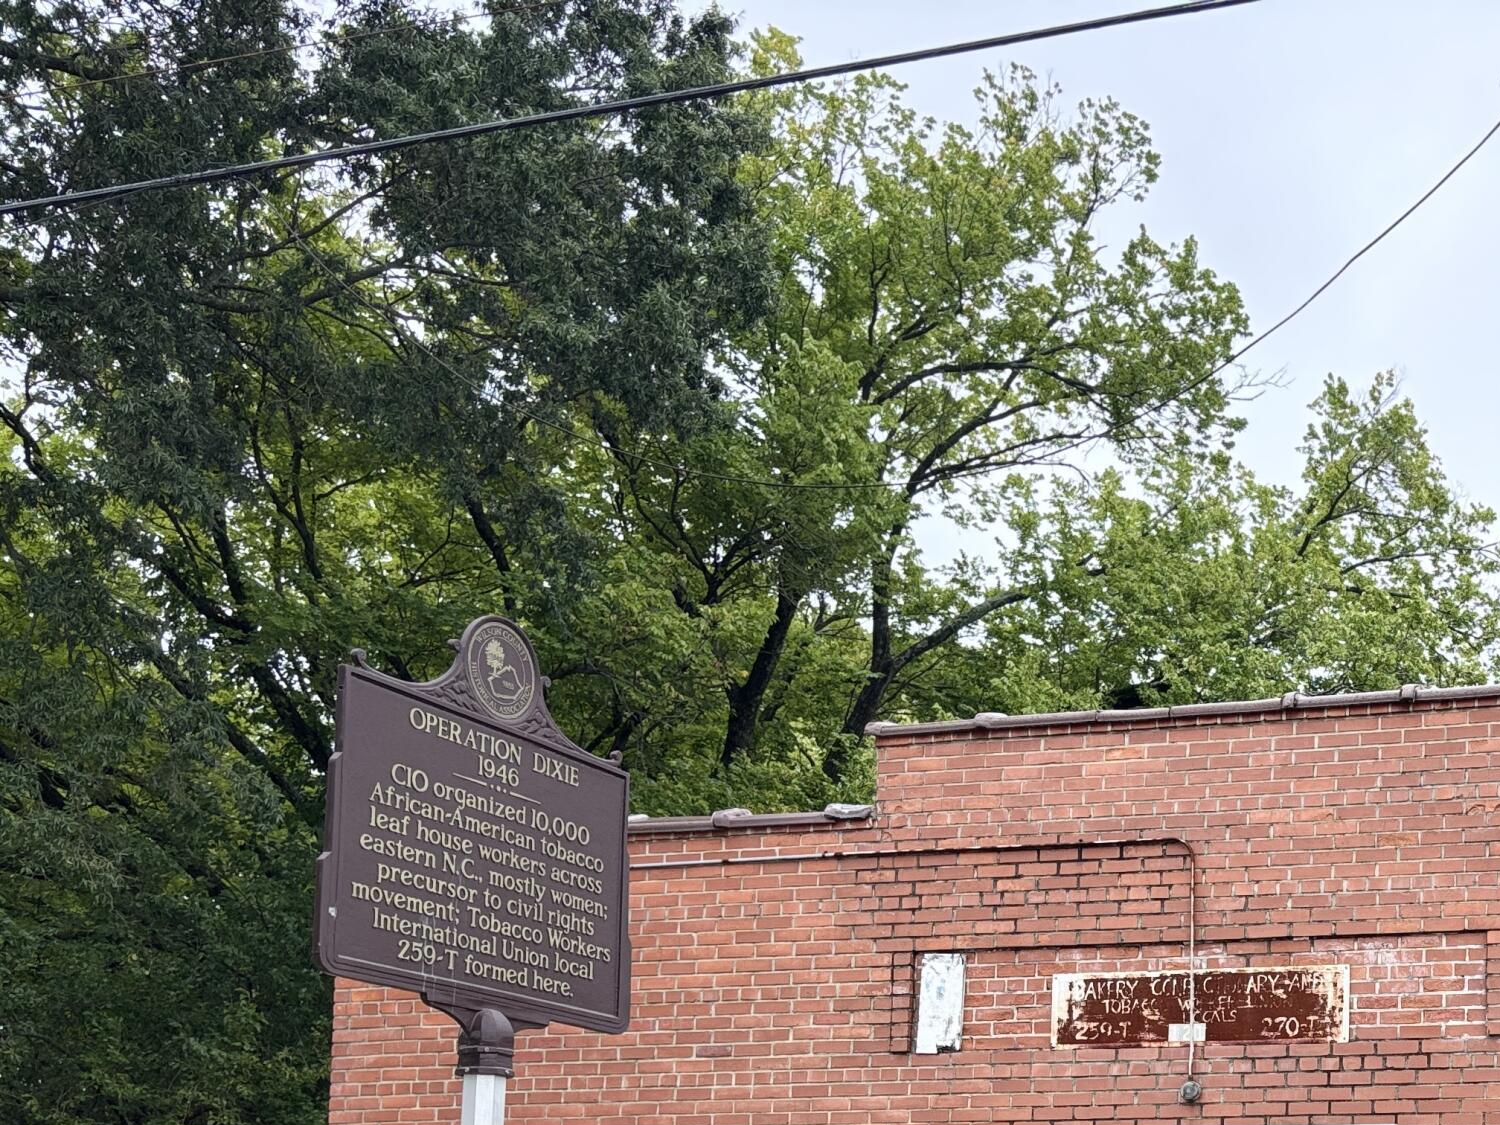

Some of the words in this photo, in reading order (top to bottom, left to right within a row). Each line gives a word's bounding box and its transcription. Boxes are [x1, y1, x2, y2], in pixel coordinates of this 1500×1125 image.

[475, 627, 502, 642] WILSON
[502, 631, 529, 662] COUNTY
[409, 707, 522, 766] OPERATION
[532, 752, 580, 787] DIXIE
[478, 755, 520, 787] 1946
[369, 782, 536, 851] African-American
[540, 836, 605, 873] tobacco
[391, 763, 429, 793] CIO
[433, 782, 526, 825] organized
[531, 808, 590, 846] 10,000
[360, 833, 436, 869] eastern
[443, 851, 483, 883] N.C.,
[489, 870, 547, 902] mostly
[550, 889, 608, 920] women;
[369, 805, 411, 836] leaf
[416, 819, 473, 854] house
[478, 844, 546, 877] workers
[551, 867, 603, 894] across
[351, 881, 460, 925] movement;
[467, 906, 543, 944] Tobacco
[547, 927, 612, 962] Workers
[377, 863, 478, 903] precursor
[483, 888, 502, 910] to
[507, 899, 544, 922] civil
[547, 910, 595, 936] rights
[372, 907, 497, 957] International
[502, 939, 550, 969] Union
[554, 952, 594, 980] local
[397, 939, 459, 970] 259-T
[464, 954, 528, 987] formed
[532, 969, 574, 998] here.
